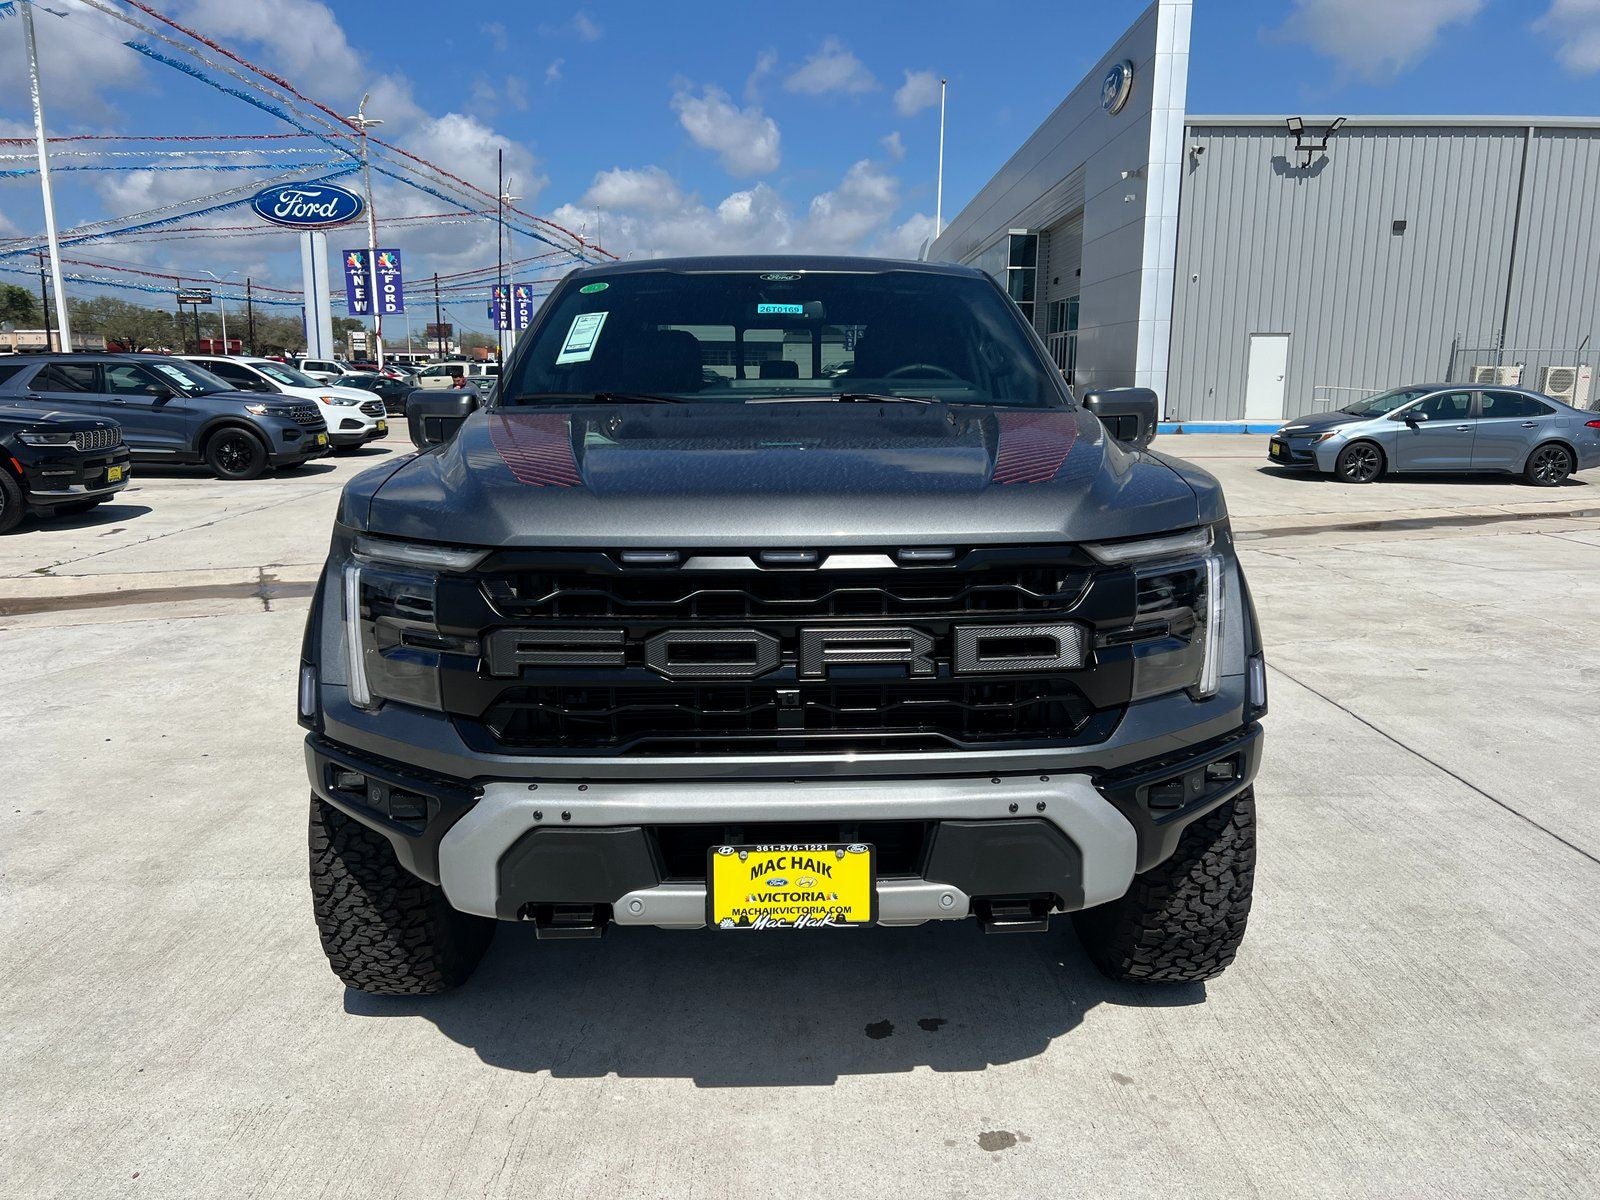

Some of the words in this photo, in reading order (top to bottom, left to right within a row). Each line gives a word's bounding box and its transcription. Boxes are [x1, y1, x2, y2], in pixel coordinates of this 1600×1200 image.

[274, 190, 339, 217] Ford
[353, 275, 368, 312] NEW
[384, 275, 396, 312] FORD
[520, 302, 528, 329] FORD
[484, 623, 1087, 681] FORD
[756, 844, 829, 852] 361-576-1221
[848, 845, 867, 853] Ford
[750, 856, 787, 881] MAC
[790, 856, 833, 880] HAIK
[768, 878, 786, 887] Ford
[757, 891, 827, 903] VICTORIA
[731, 905, 853, 917] MACHAIKVICTORIA.COM
[751, 912, 793, 931] Mac
[793, 912, 842, 929] Haik
